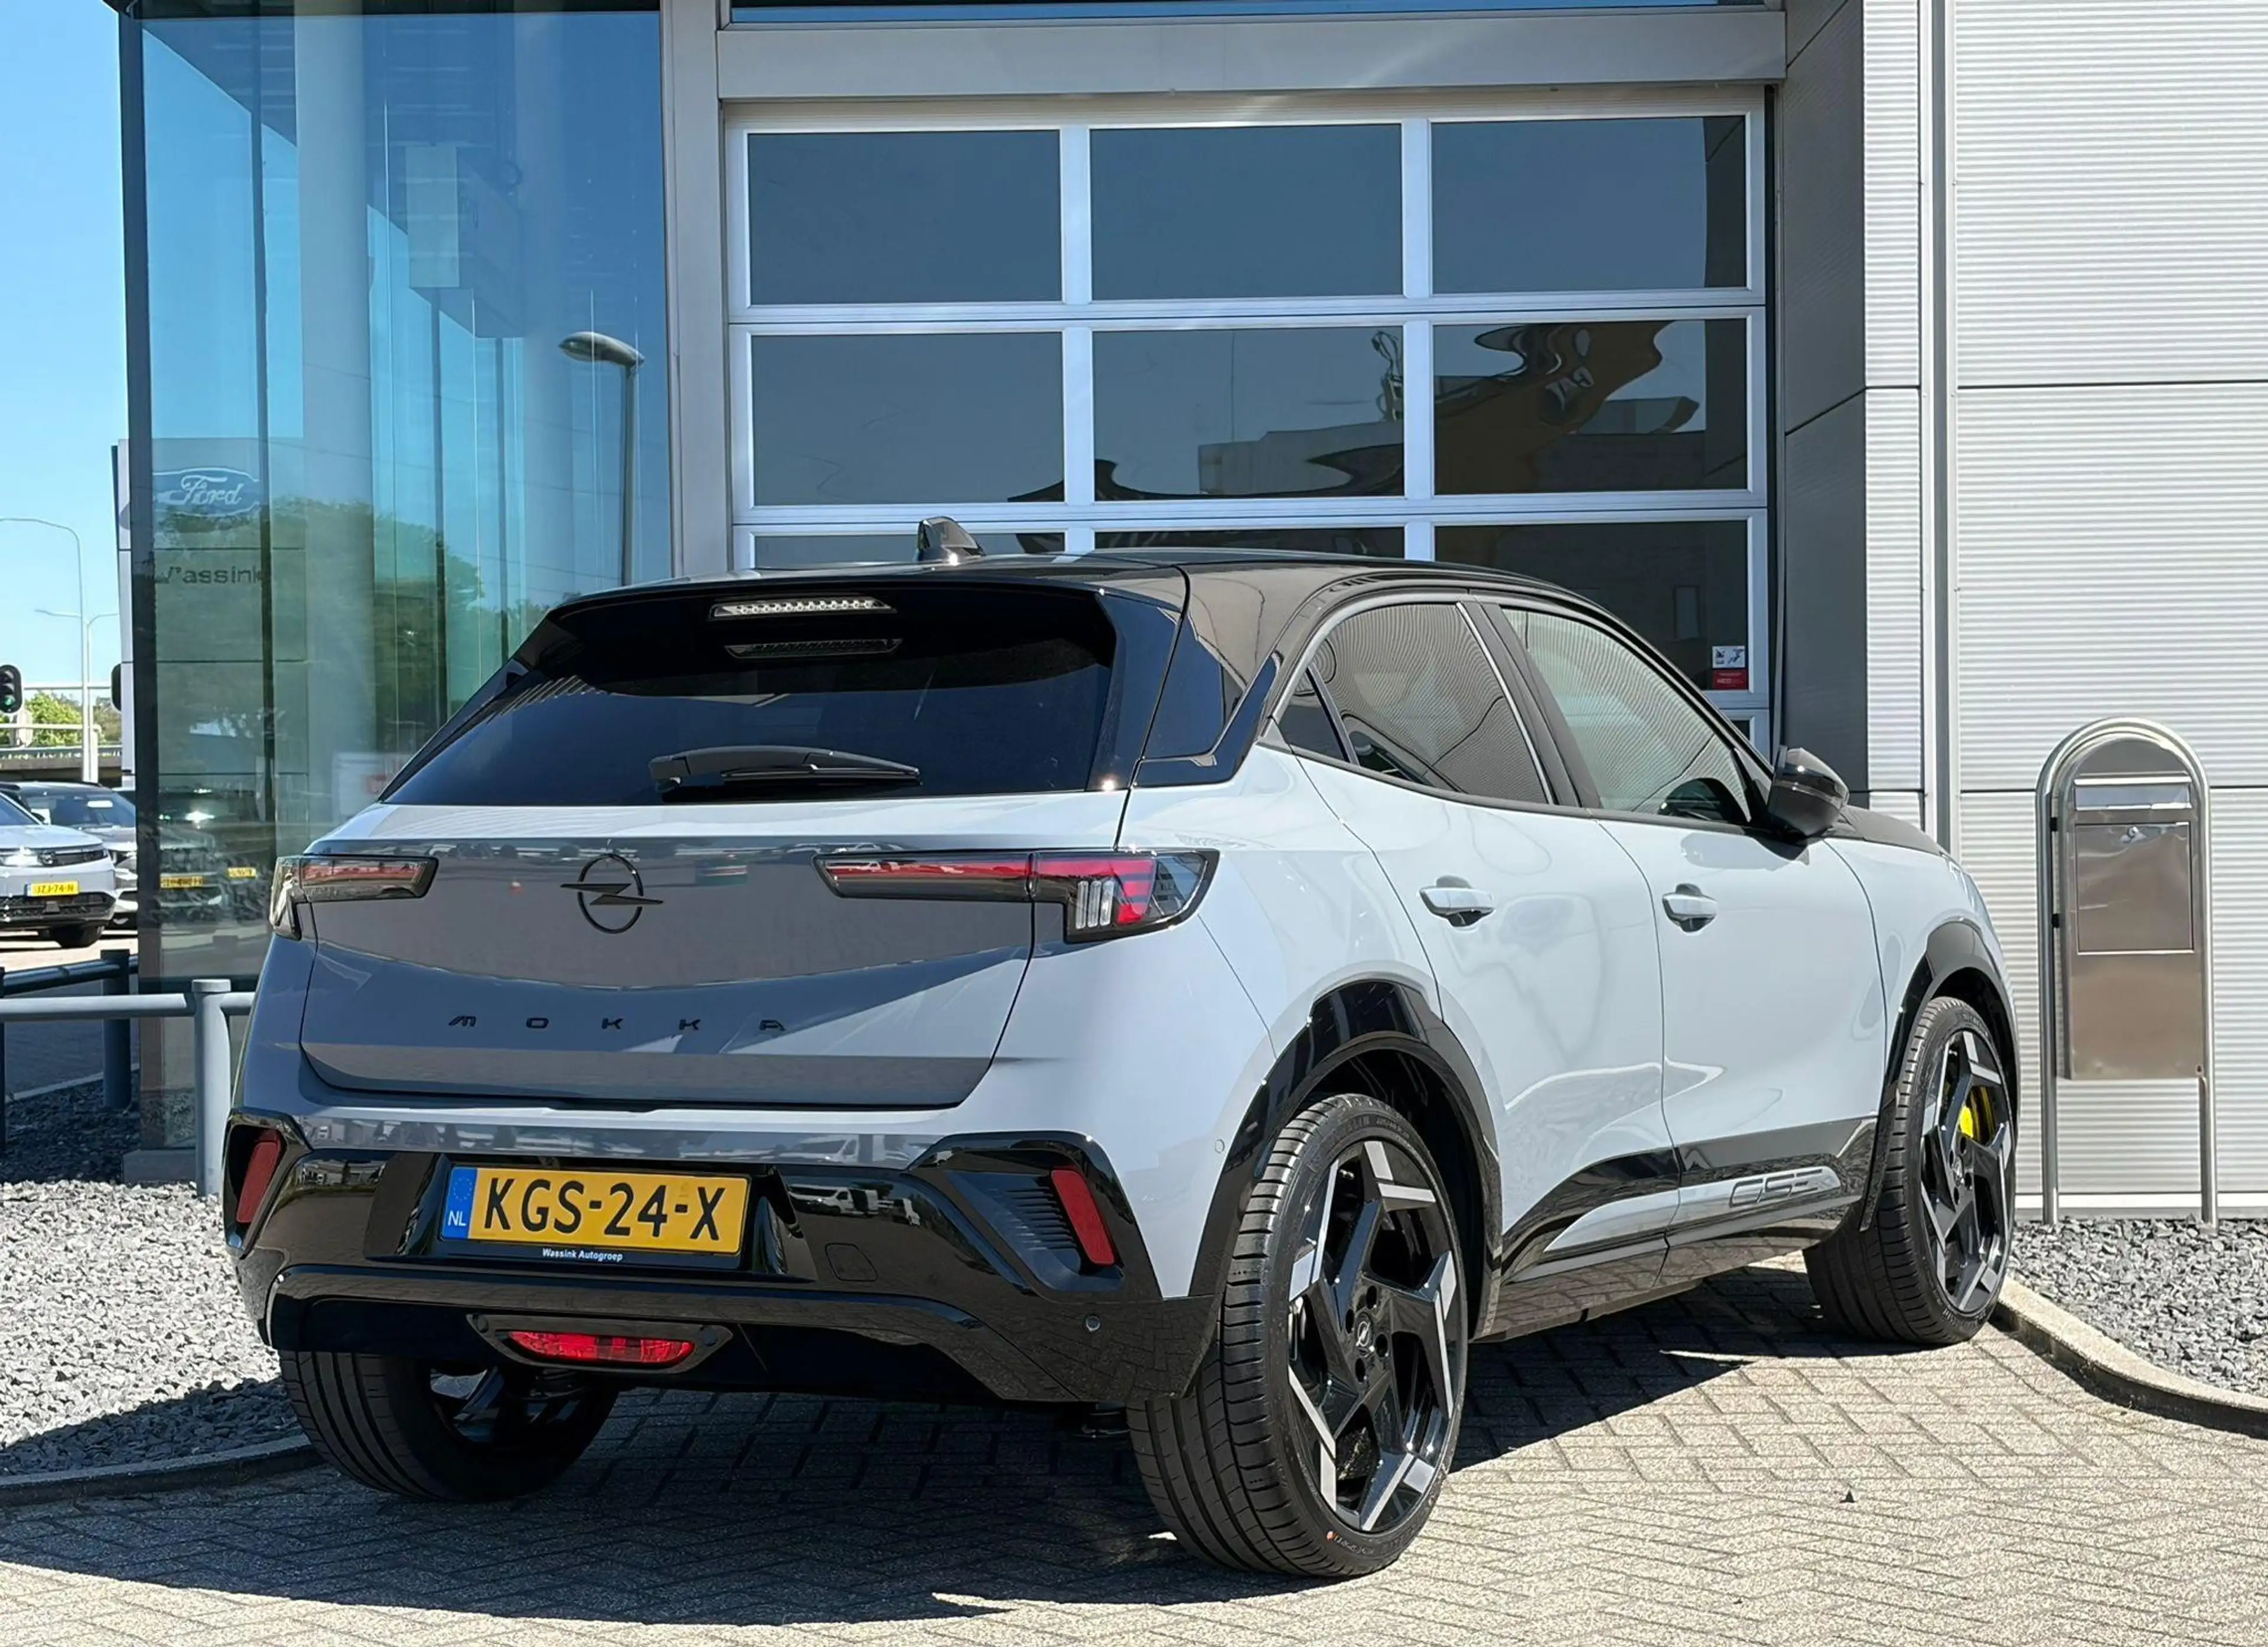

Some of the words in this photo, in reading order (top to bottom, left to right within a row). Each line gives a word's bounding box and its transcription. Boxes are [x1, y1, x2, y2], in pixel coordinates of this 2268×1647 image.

[169, 474, 245, 506] Ford
[448, 1015, 786, 1031] MOKKA
[484, 1177, 726, 1241] KGS-24-X
[448, 1210, 467, 1226] NL
[542, 1247, 577, 1259] Wassink
[579, 1248, 624, 1262] Autogroep
